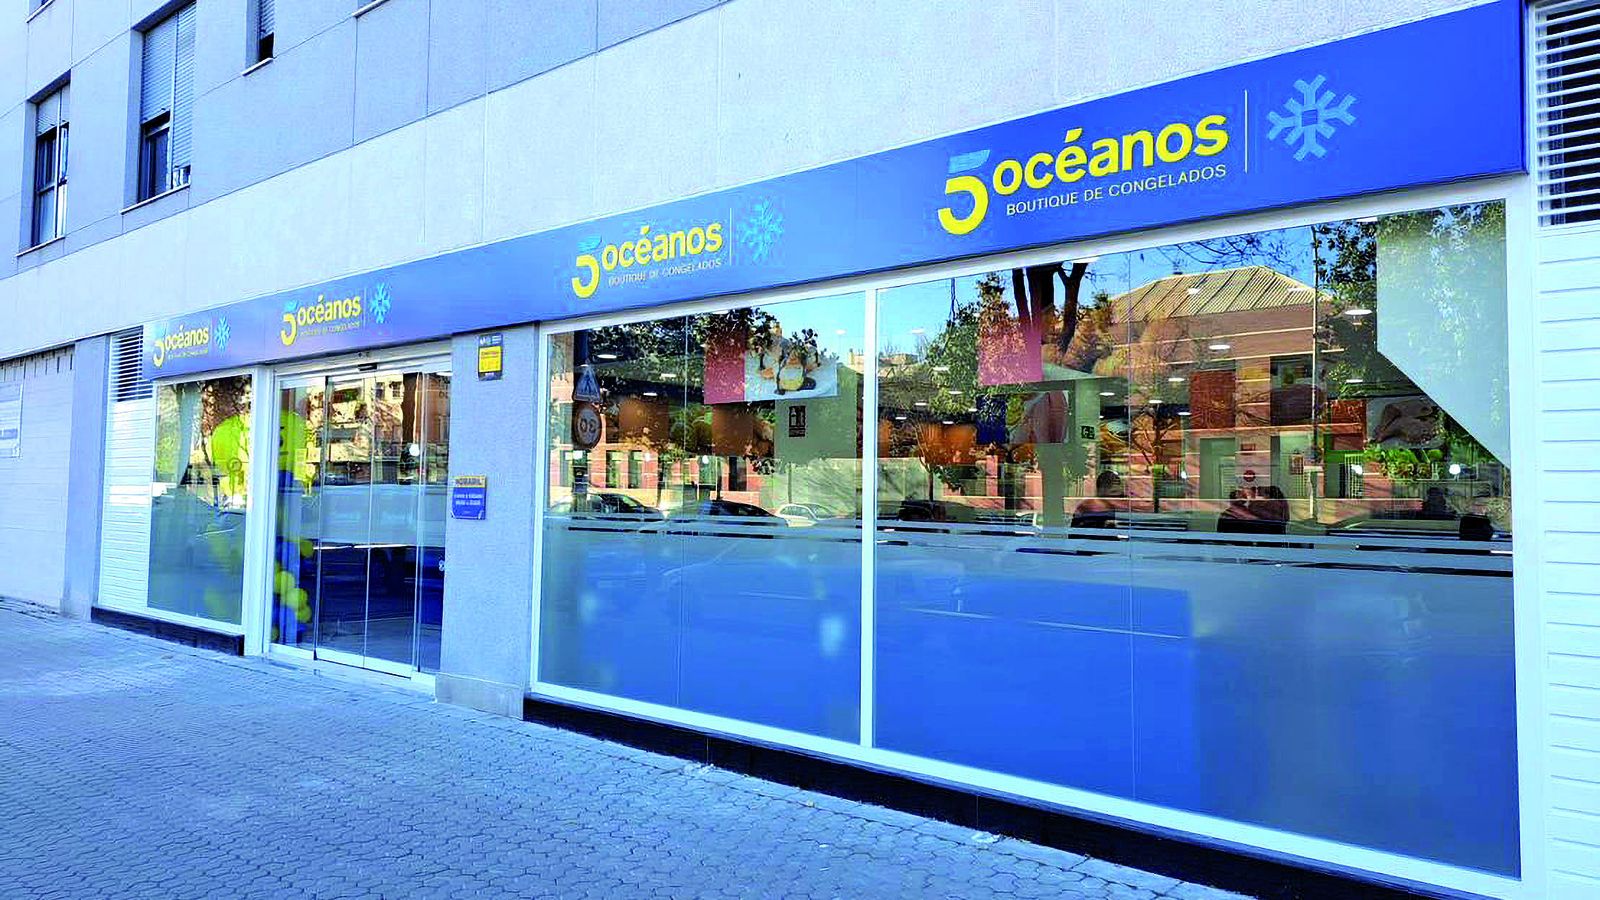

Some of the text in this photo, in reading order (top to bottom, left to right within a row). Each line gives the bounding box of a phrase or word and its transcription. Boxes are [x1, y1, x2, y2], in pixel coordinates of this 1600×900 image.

[938, 114, 1230, 235] 5 océanos
[1006, 164, 1227, 216] BOUTIQUE DE CONGELADOS
[571, 222, 724, 299] 5 océanos
[165, 324, 210, 351] océanos
[281, 300, 298, 346] 5
[297, 294, 362, 327] océanos
